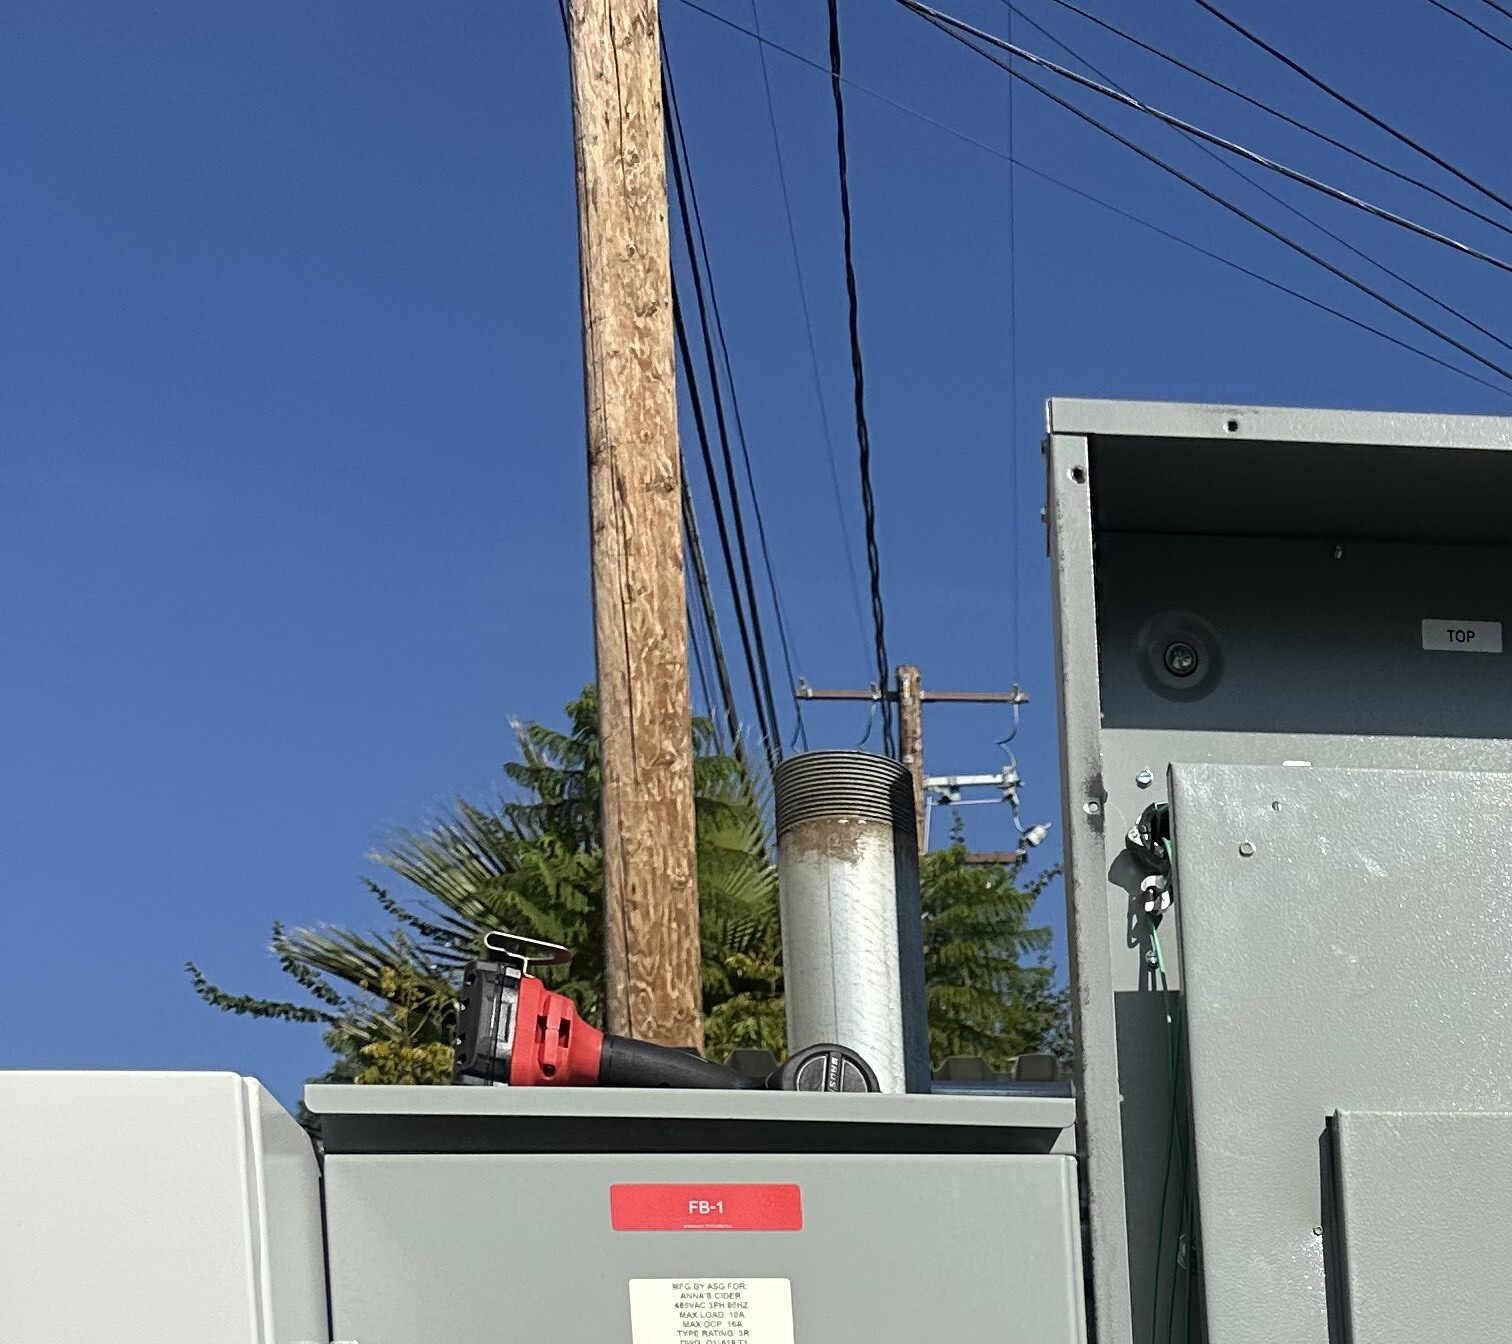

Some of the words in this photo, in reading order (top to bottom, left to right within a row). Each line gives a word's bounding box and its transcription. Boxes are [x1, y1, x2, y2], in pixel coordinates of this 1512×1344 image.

[1447, 629, 1475, 643] TOP
[688, 1200, 723, 1214] FB-1
[679, 1311, 698, 1319] MAX
[683, 1320, 701, 1328] MAX
